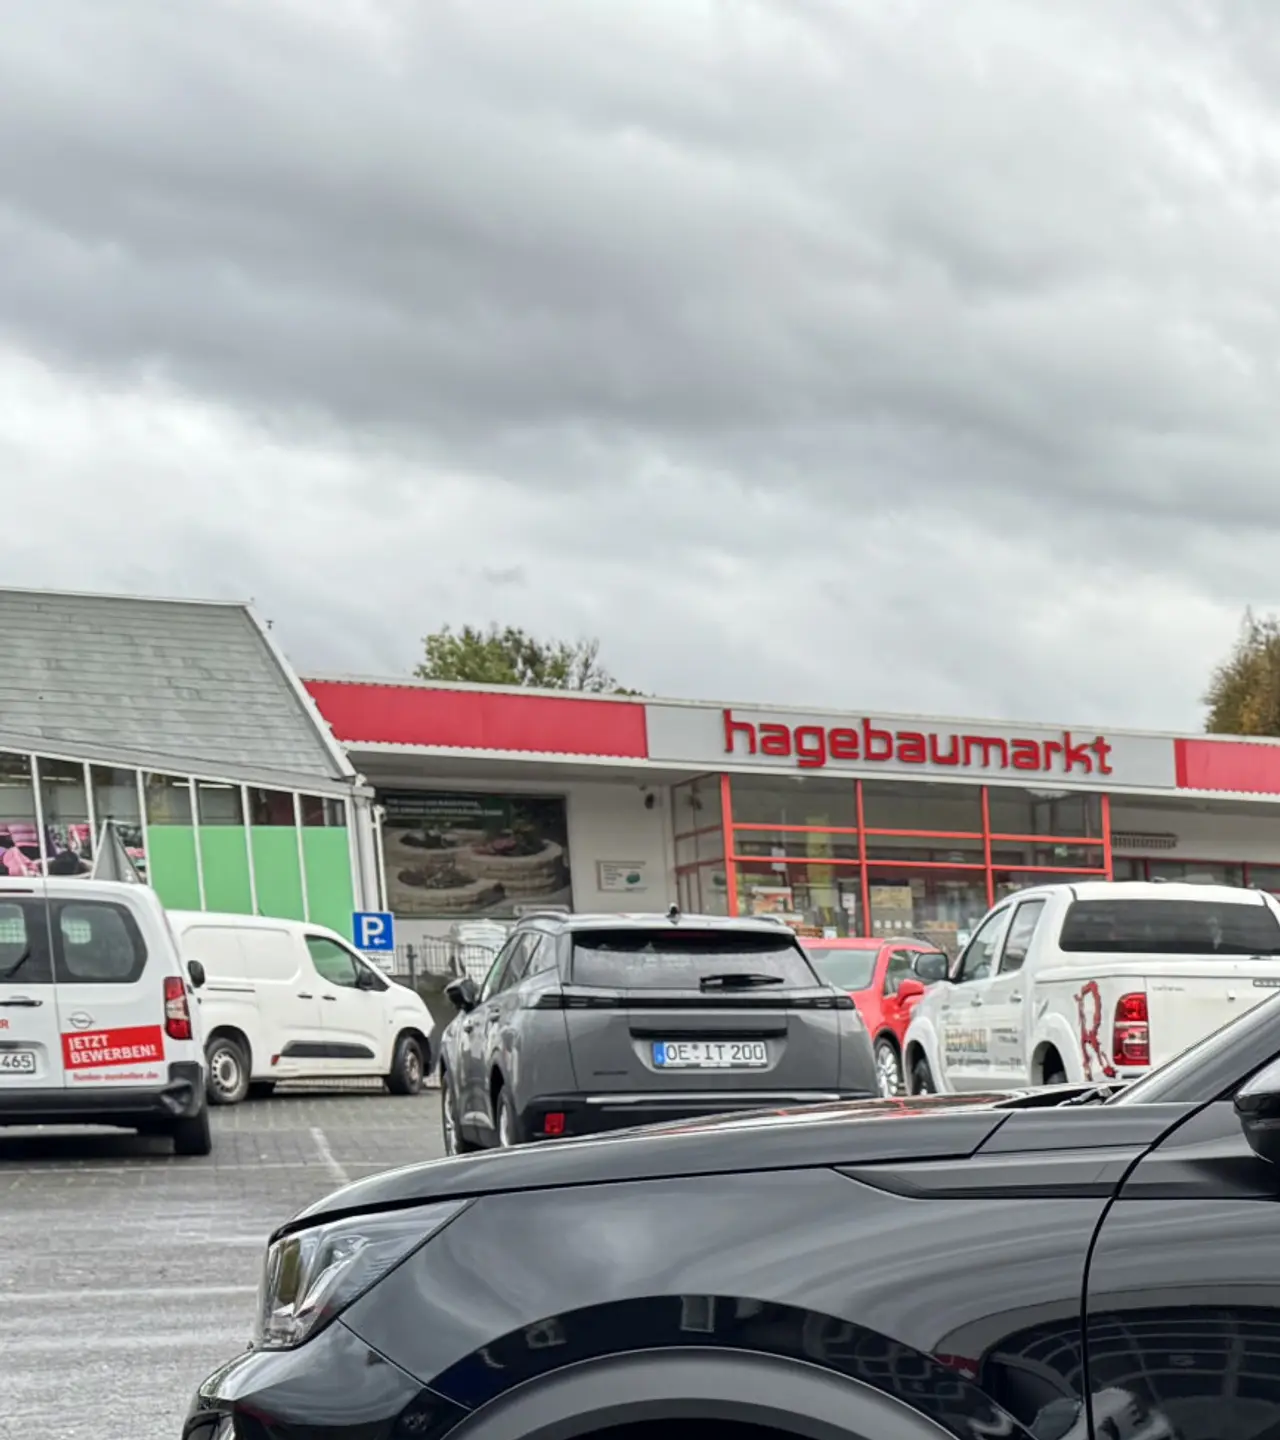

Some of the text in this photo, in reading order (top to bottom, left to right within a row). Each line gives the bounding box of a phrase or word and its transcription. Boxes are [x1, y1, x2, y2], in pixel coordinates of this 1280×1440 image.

[722, 709, 1112, 774] hagebaumarkt
[361, 916, 384, 946] P
[68, 1034, 109, 1051] JETZT
[666, 1044, 764, 1061] OE IT 200
[70, 1044, 157, 1064] BEWERBEN!
